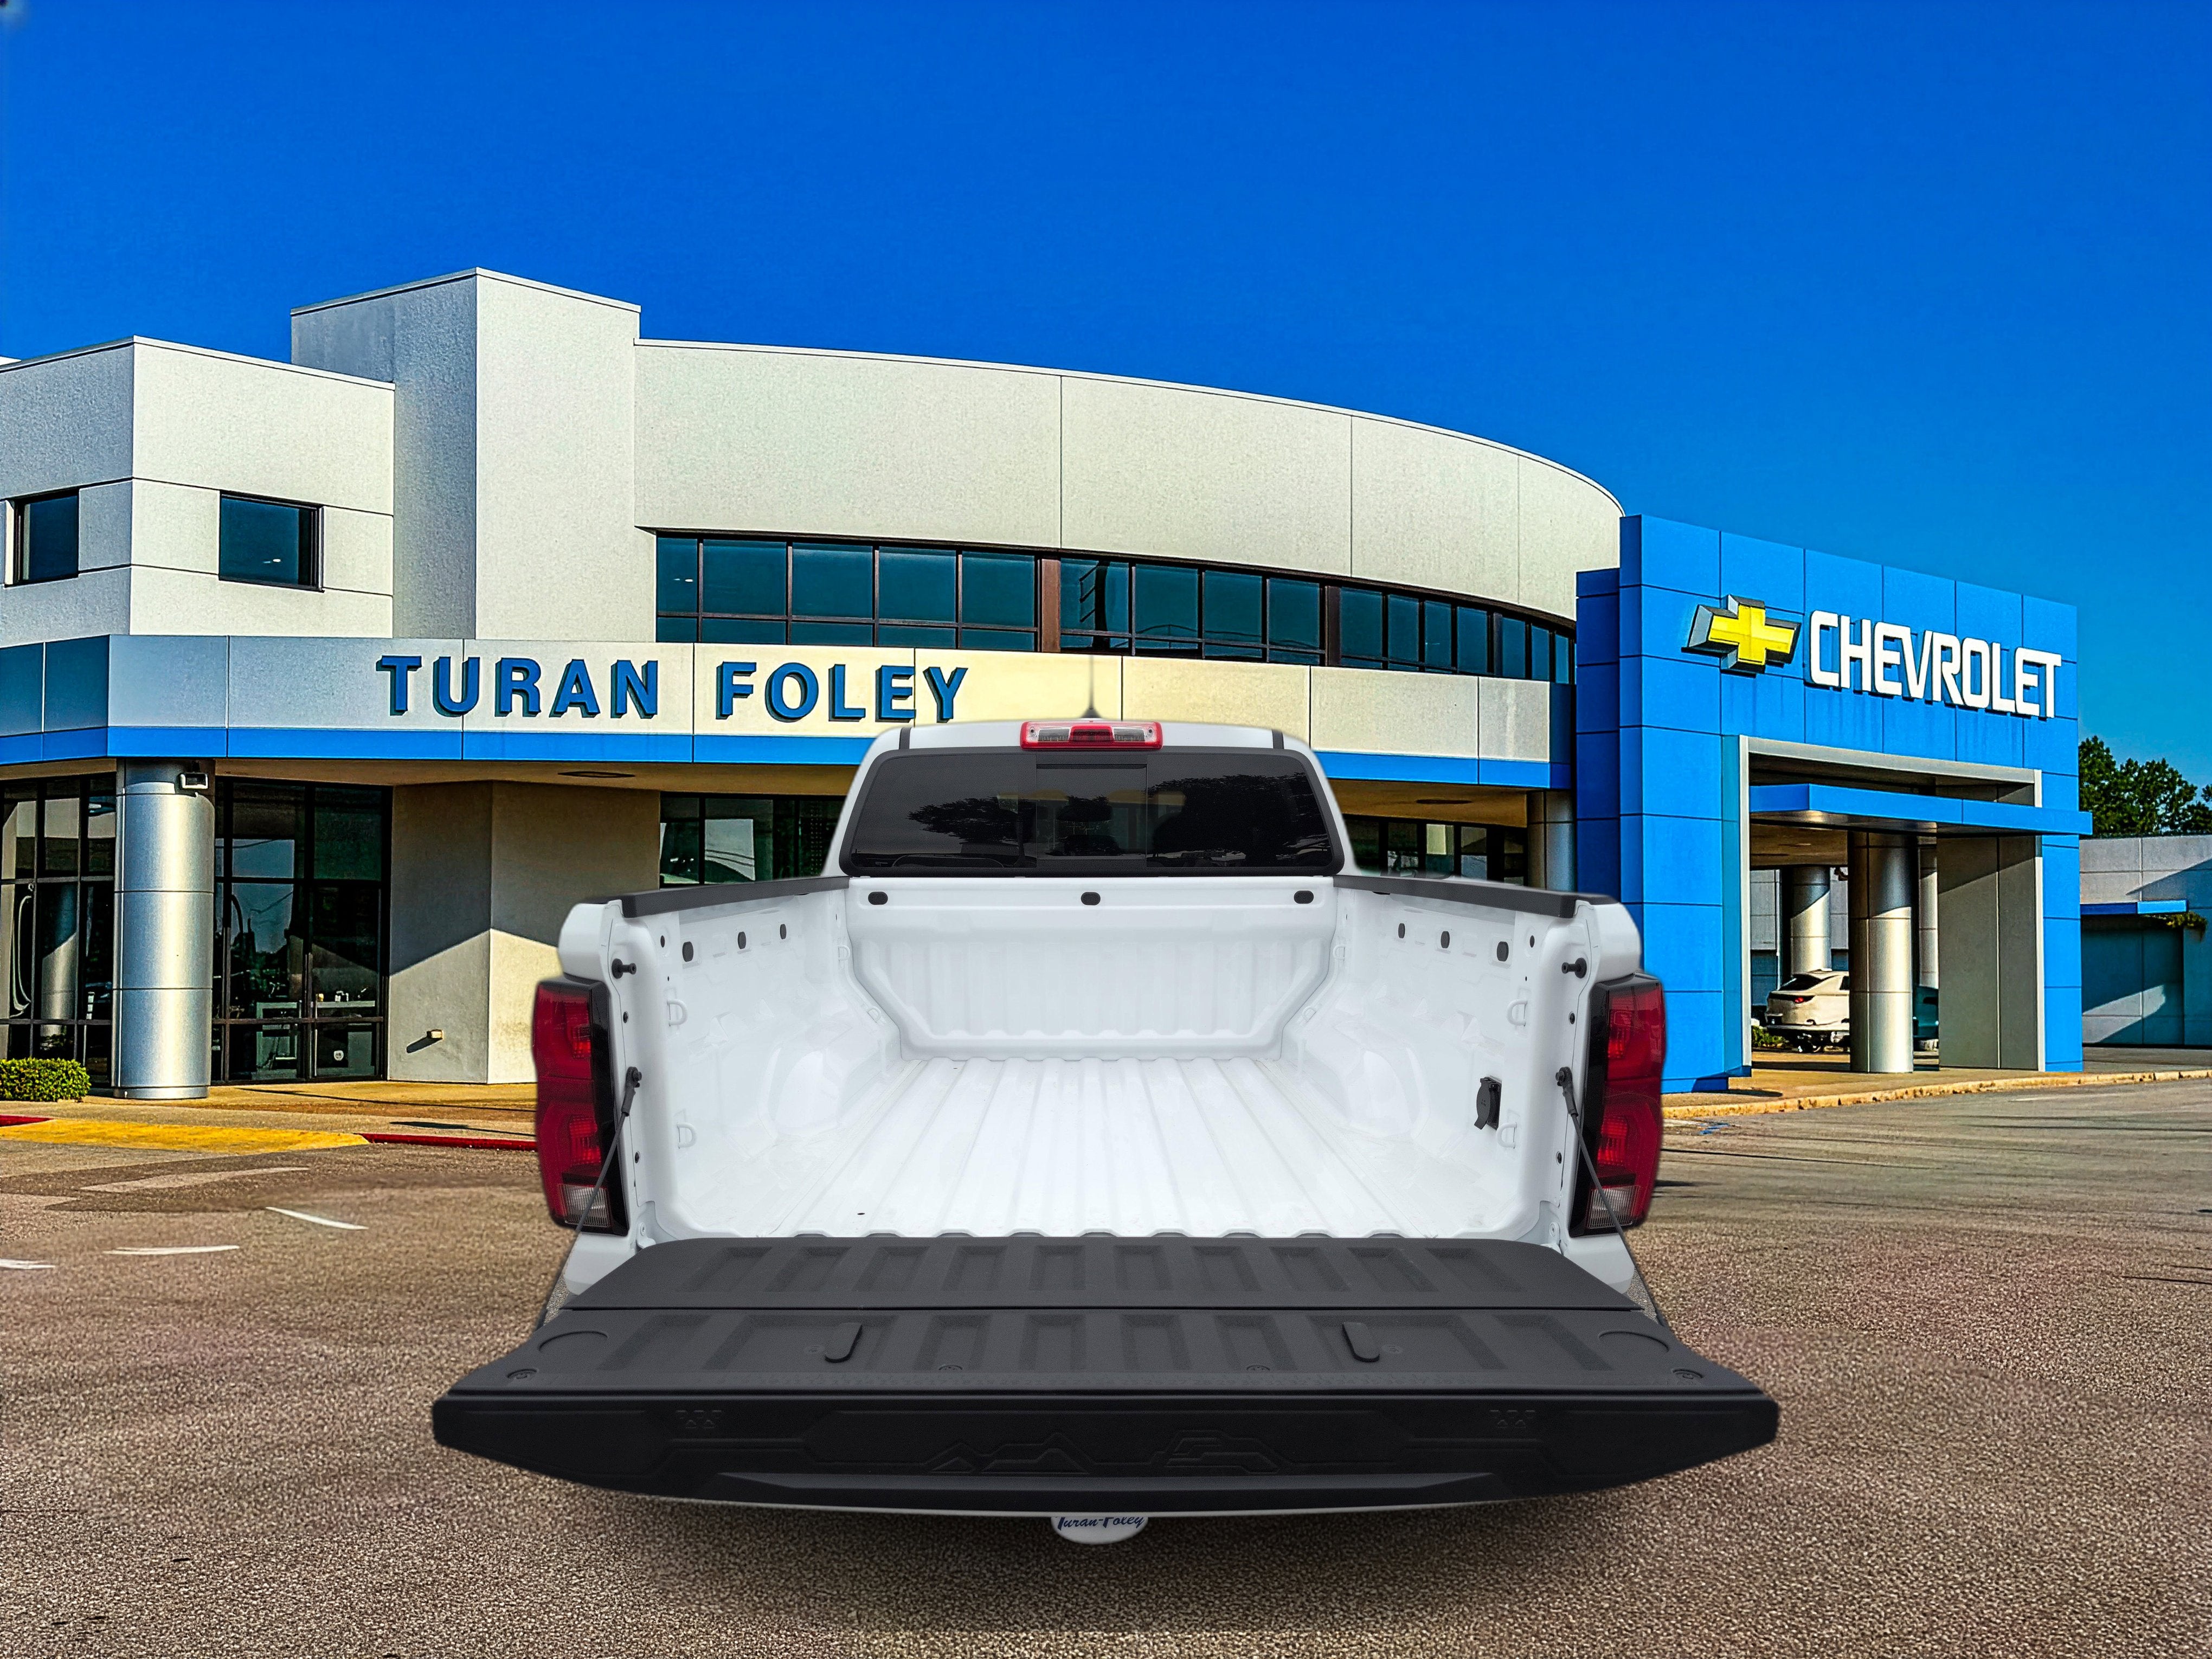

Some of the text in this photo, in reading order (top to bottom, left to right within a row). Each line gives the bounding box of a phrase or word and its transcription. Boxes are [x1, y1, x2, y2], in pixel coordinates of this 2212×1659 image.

[377, 655, 968, 723] TURAN FOLEY
[1809, 610, 2062, 718] CHEVROLET
